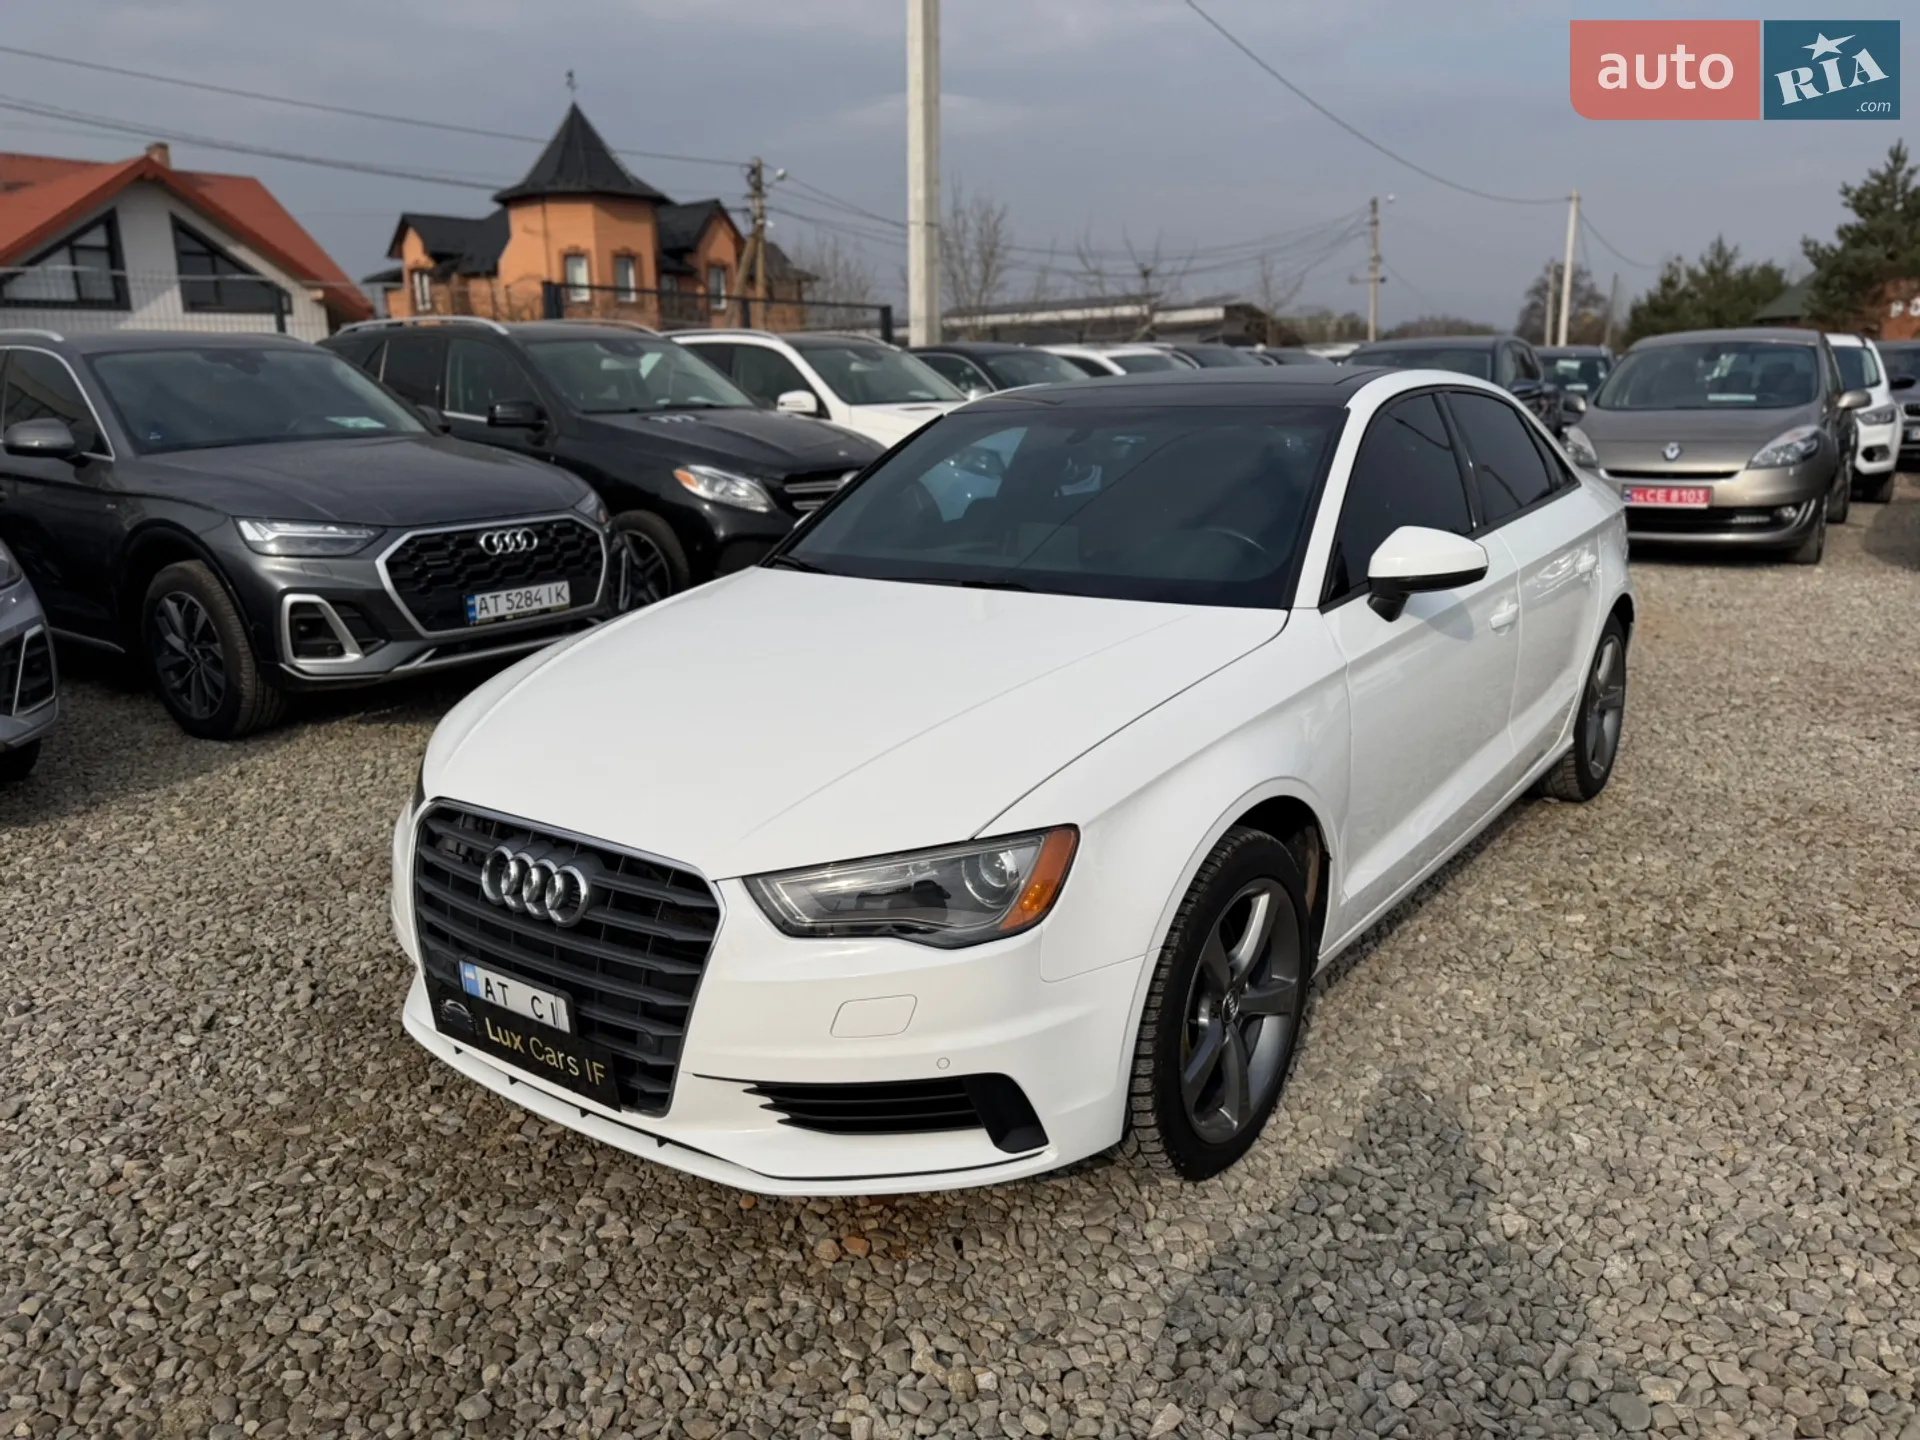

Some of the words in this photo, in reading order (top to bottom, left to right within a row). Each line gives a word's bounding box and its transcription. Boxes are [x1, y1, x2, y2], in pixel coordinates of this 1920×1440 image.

[478, 594, 502, 615] AT
[505, 587, 543, 611] 5284
[548, 584, 567, 604] IK
[484, 977, 509, 1007] AT
[530, 995, 557, 1026] CI
[485, 1016, 525, 1054] Lux
[529, 1036, 580, 1076] Cars
[585, 1058, 605, 1086] IF
